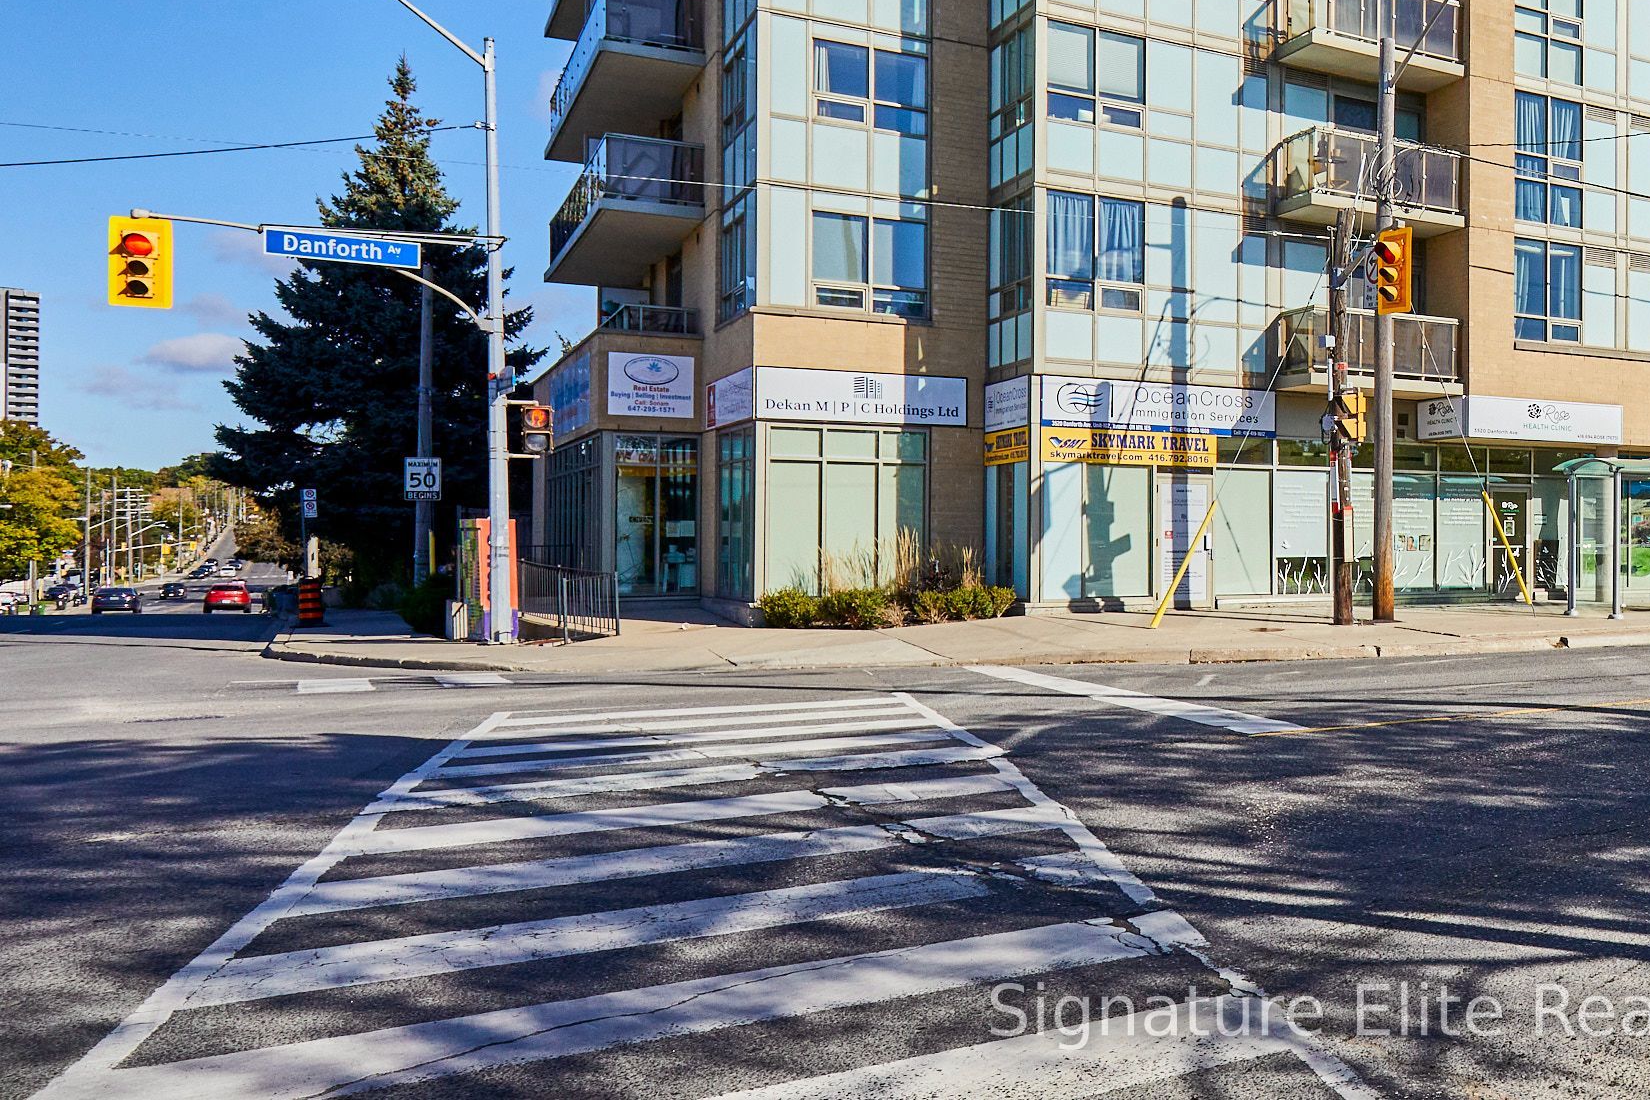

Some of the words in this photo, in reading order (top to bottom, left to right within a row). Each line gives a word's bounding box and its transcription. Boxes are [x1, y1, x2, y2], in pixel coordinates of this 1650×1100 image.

[283, 233, 383, 260] Danforth
[387, 244, 402, 256] Av
[610, 391, 631, 399] Buying
[635, 392, 656, 400] Selling
[633, 384, 648, 392] Real
[649, 385, 670, 393] Estate
[1135, 386, 1253, 409] OceanCross
[765, 398, 811, 411] Dekan
[815, 400, 828, 412] M
[840, 402, 850, 412] P
[860, 403, 870, 414] C
[874, 403, 934, 418] Holdings
[938, 406, 959, 418] Ltd
[1131, 407, 1205, 421] Immigration
[1209, 411, 1259, 424] Services
[1543, 404, 1571, 425] Rose
[1441, 416, 1454, 425] CLINIC
[1523, 423, 1550, 431] HEALTH
[1550, 424, 1573, 432] CLINIC
[1059, 438, 1088, 449] SMT
[1091, 432, 1156, 450] SKYMARK
[1161, 436, 1209, 452] TRAVEL
[1050, 450, 1143, 461] skymarktravel.com
[1148, 454, 1209, 463] 416.792.8016
[409, 472, 437, 489] 50
[407, 491, 438, 499] BEGINS
